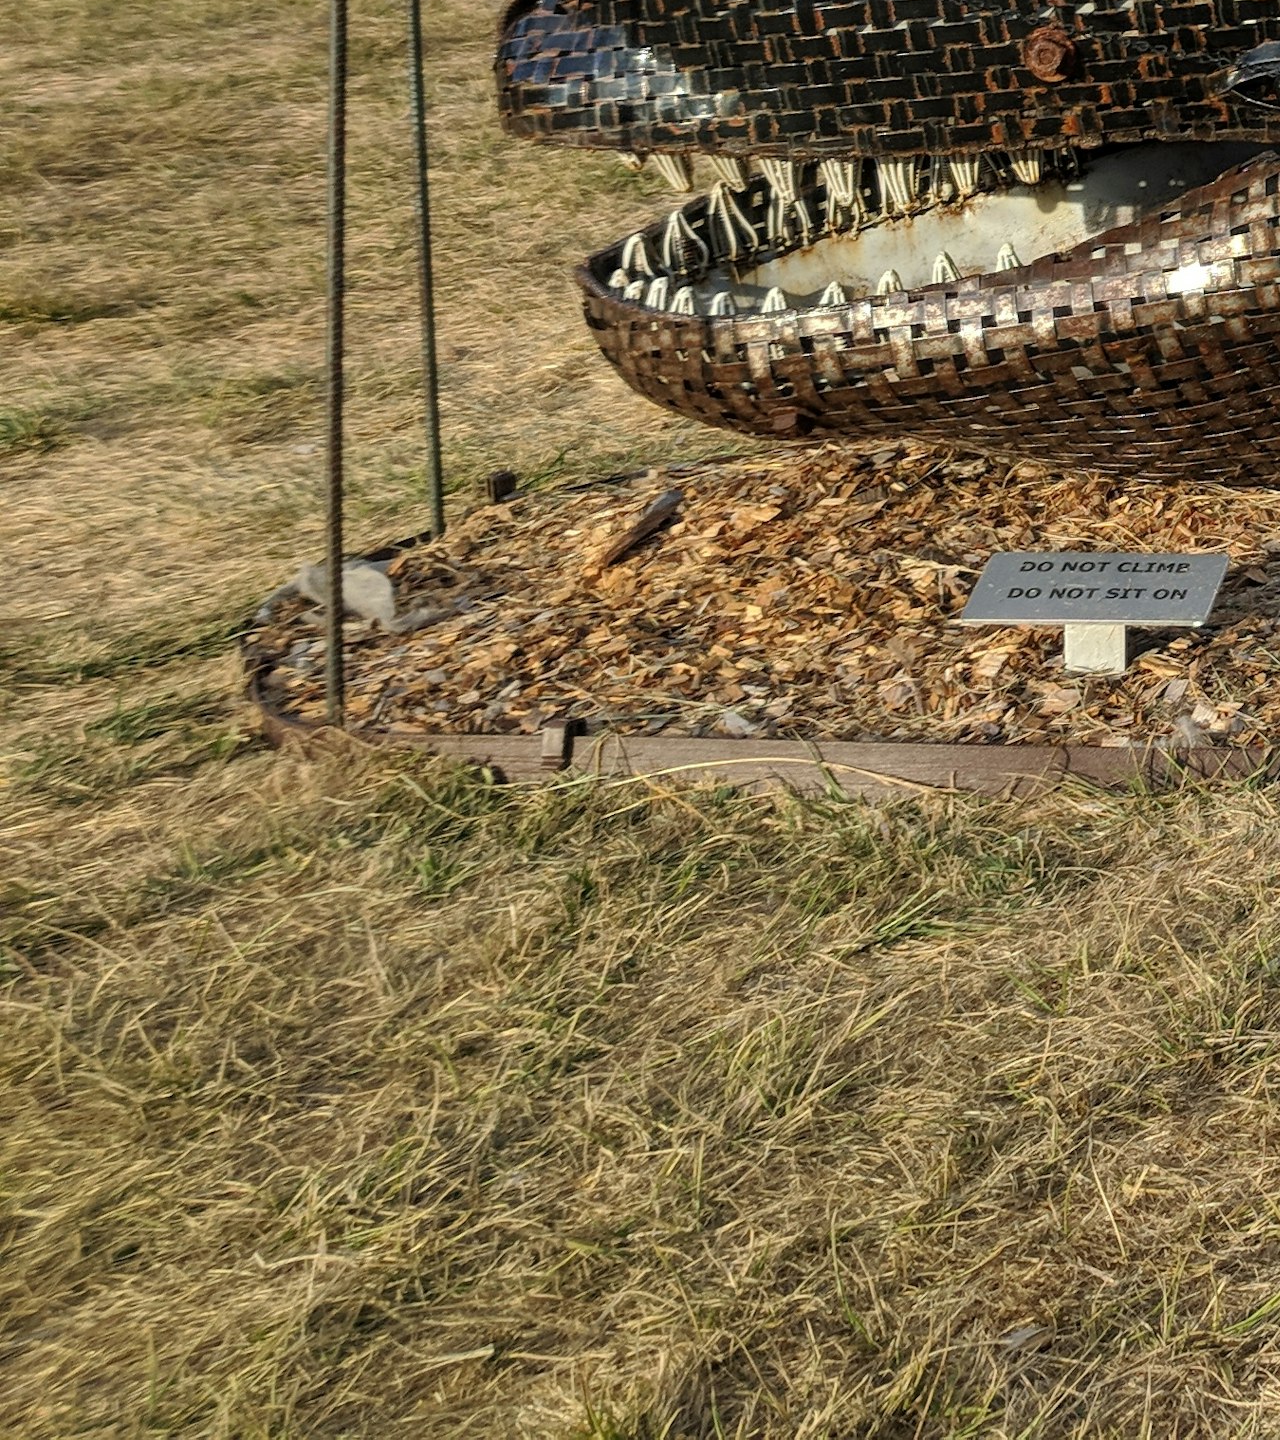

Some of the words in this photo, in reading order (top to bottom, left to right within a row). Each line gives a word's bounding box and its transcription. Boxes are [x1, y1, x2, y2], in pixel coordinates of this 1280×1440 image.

[1020, 561, 1054, 572] DO
[1061, 561, 1112, 573] NOT
[1117, 562, 1191, 574] CLIMB
[1007, 587, 1042, 599] DO
[1048, 588, 1100, 600] NOT
[1105, 588, 1147, 600] SIT
[1152, 588, 1189, 601] ON
